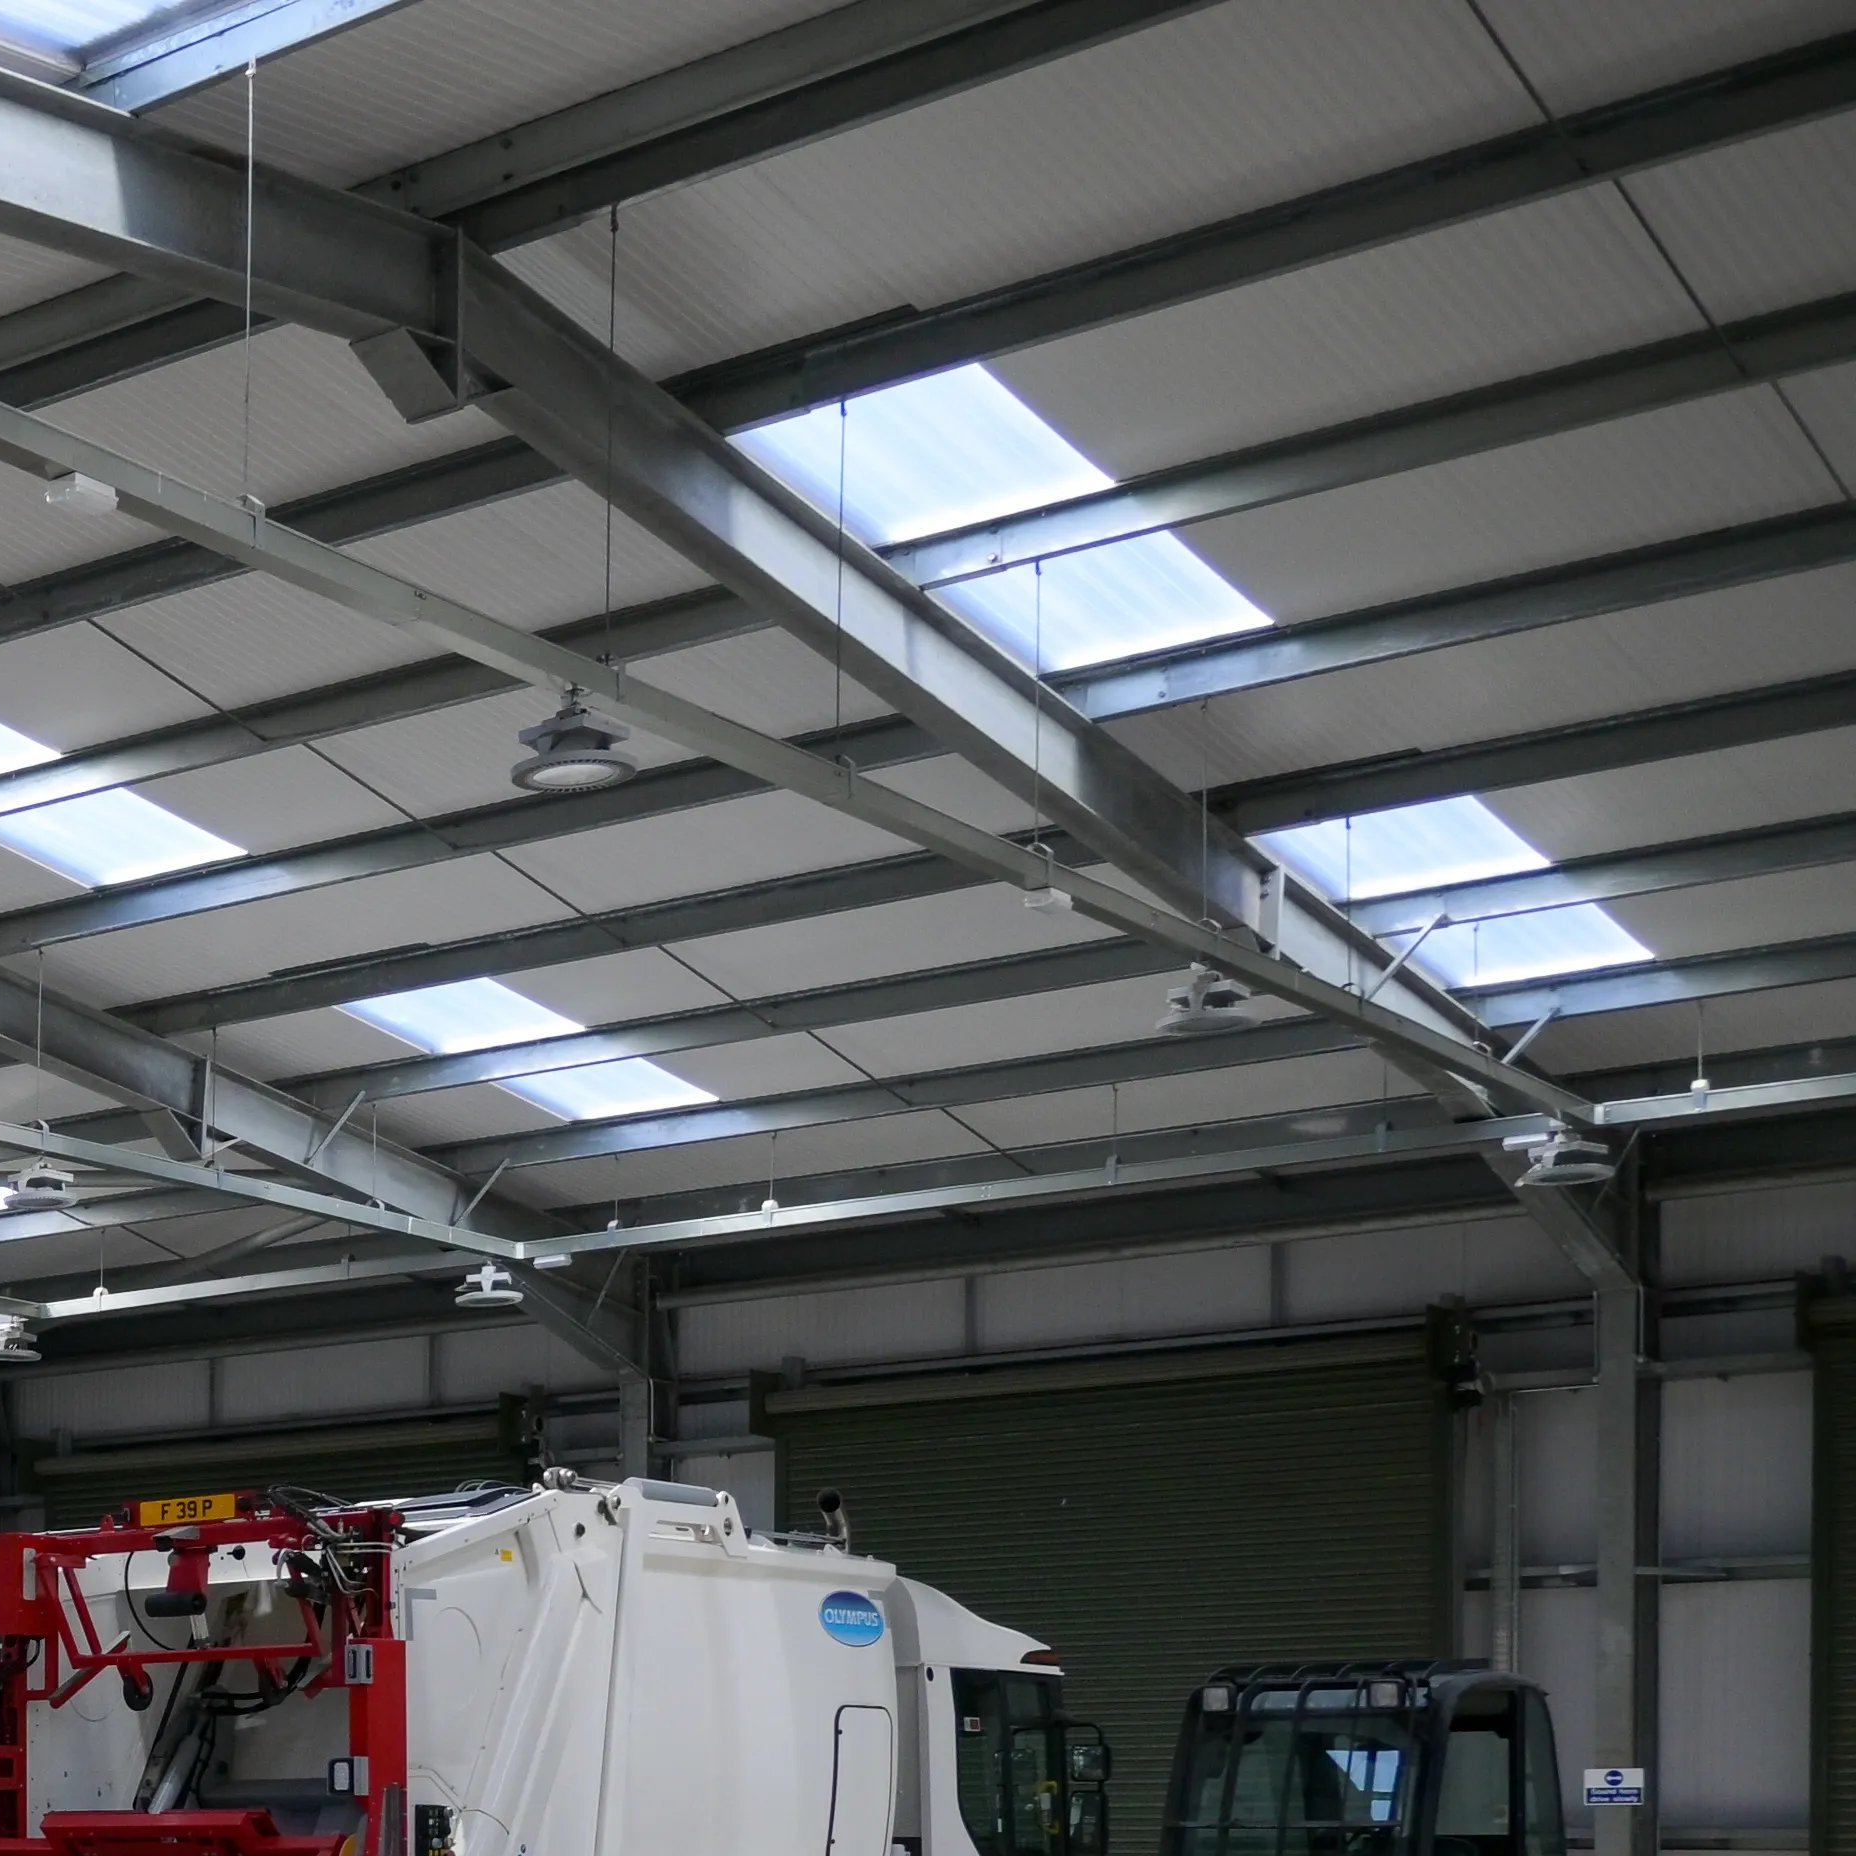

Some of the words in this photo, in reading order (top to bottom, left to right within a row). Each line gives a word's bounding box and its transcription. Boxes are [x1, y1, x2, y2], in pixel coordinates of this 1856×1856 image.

[161, 1503, 170, 1520] F
[176, 1501, 197, 1519] 39
[202, 1499, 212, 1517] P
[824, 1608, 878, 1627] OLYMPUS
